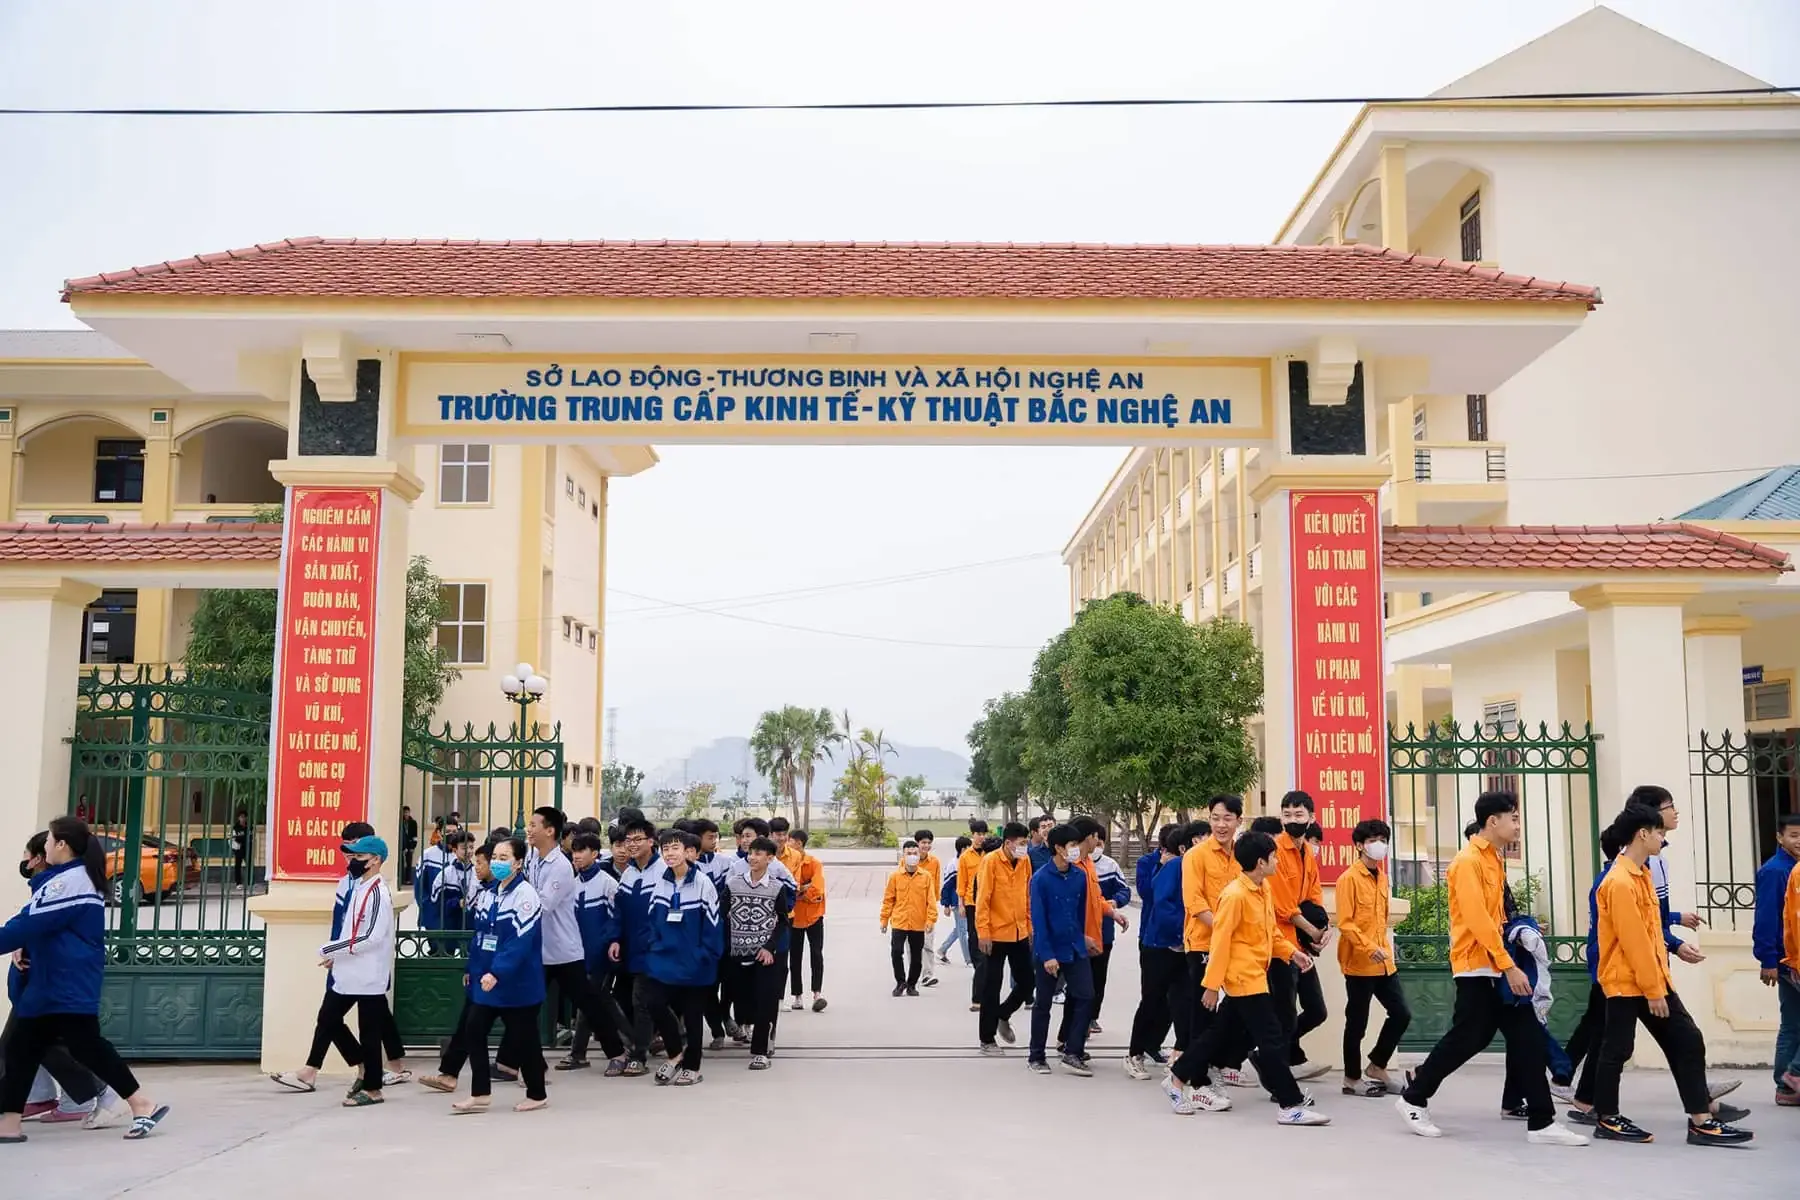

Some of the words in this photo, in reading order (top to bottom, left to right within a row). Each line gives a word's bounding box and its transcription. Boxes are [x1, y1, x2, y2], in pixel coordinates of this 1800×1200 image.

[527, 364, 562, 387] SỞ
[572, 369, 621, 387] LAO
[830, 370, 886, 388] BINH
[895, 366, 928, 388] VÀ
[936, 368, 969, 388] XÃ
[976, 366, 1020, 392] HỘI
[1030, 368, 1100, 390] NGHỆ
[1108, 372, 1143, 389] AN
[438, 389, 556, 421] TRƯỜNG
[566, 396, 662, 421] TRUNG
[673, 388, 735, 421] CẤP
[745, 396, 818, 421] KINH
[925, 392, 1019, 427] THUẬT
[1029, 389, 1088, 424] BẮC
[1097, 394, 1178, 428] NGHỆ
[1190, 398, 1231, 424] AN
[302, 506, 343, 525] NGHIÊM
[347, 505, 371, 525] CẤM
[1304, 510, 1329, 534] KIÊN
[1332, 508, 1366, 536] QUYẾT
[302, 534, 323, 552] CÁC
[327, 535, 354, 552] HÀNH
[358, 537, 368, 552] VI
[1308, 544, 1329, 570] ĐẤU
[1332, 550, 1366, 570] TRANH
[304, 560, 327, 580] SẢN
[330, 561, 362, 583] XUẤT,
[303, 590, 332, 608] BUÔN
[336, 590, 360, 611] BÁN,
[1315, 582, 1333, 607] VỚI
[1336, 583, 1357, 607] CÁC
[295, 617, 317, 639] VẬN
[321, 616, 366, 639] CHUYỂN,
[1318, 619, 1346, 643] HÀNH
[1349, 623, 1359, 643] VI
[304, 646, 331, 665] TÀNG
[336, 646, 356, 665] TRỮ
[1316, 659, 1326, 680] VI
[1330, 659, 1360, 684] PHẠM
[295, 674, 310, 693] VÀ
[314, 673, 329, 693] SỬ
[332, 676, 361, 698] DỤNG
[305, 702, 319, 722] VŨ
[324, 703, 344, 724] KHÍ,
[1312, 690, 1326, 717] VỀ
[1330, 692, 1344, 717] VŨ
[1348, 692, 1369, 719] KHÍ,
[289, 731, 311, 753] VẬT
[315, 731, 339, 753] LIỆU
[343, 729, 361, 752] NỔ,
[1306, 728, 1327, 758] VẬT
[1331, 729, 1354, 758] LIỆU
[1358, 726, 1376, 757] NỔ,
[299, 760, 327, 779] CÔNG
[331, 763, 345, 782] CỤ
[1319, 767, 1347, 791] CÔNG
[1351, 770, 1364, 795] CỤ
[302, 785, 316, 808] HỖ
[320, 789, 341, 811] TRỢ
[1322, 800, 1335, 828] HỖ
[288, 817, 302, 836] VÀ
[306, 817, 328, 837] CÁC
[307, 847, 335, 866] PHÁO
[1321, 841, 1336, 866] VÀ
[1340, 844, 1360, 866] PH
